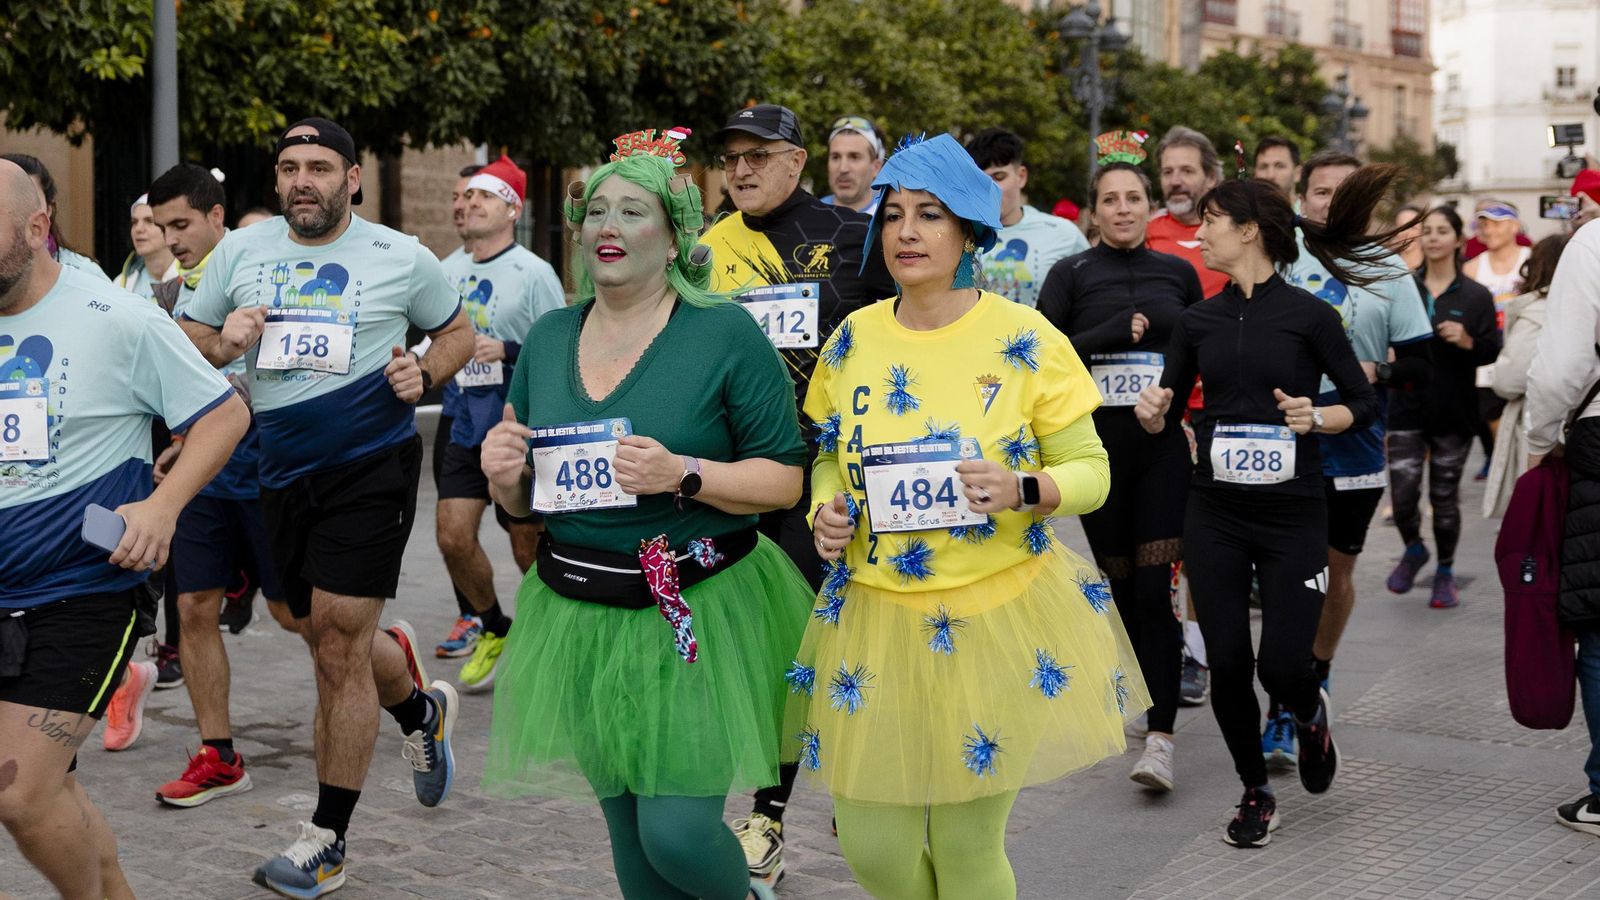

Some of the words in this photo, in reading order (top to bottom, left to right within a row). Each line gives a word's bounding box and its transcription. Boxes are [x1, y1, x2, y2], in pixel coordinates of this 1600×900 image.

[280, 333, 329, 358] 158
[1101, 374, 1154, 394] 1287
[49, 358, 69, 464] GADITANA
[1221, 449, 1282, 472] 1288
[556, 457, 612, 491] 488
[890, 477, 958, 511] 484
[917, 513, 940, 526] Forus
